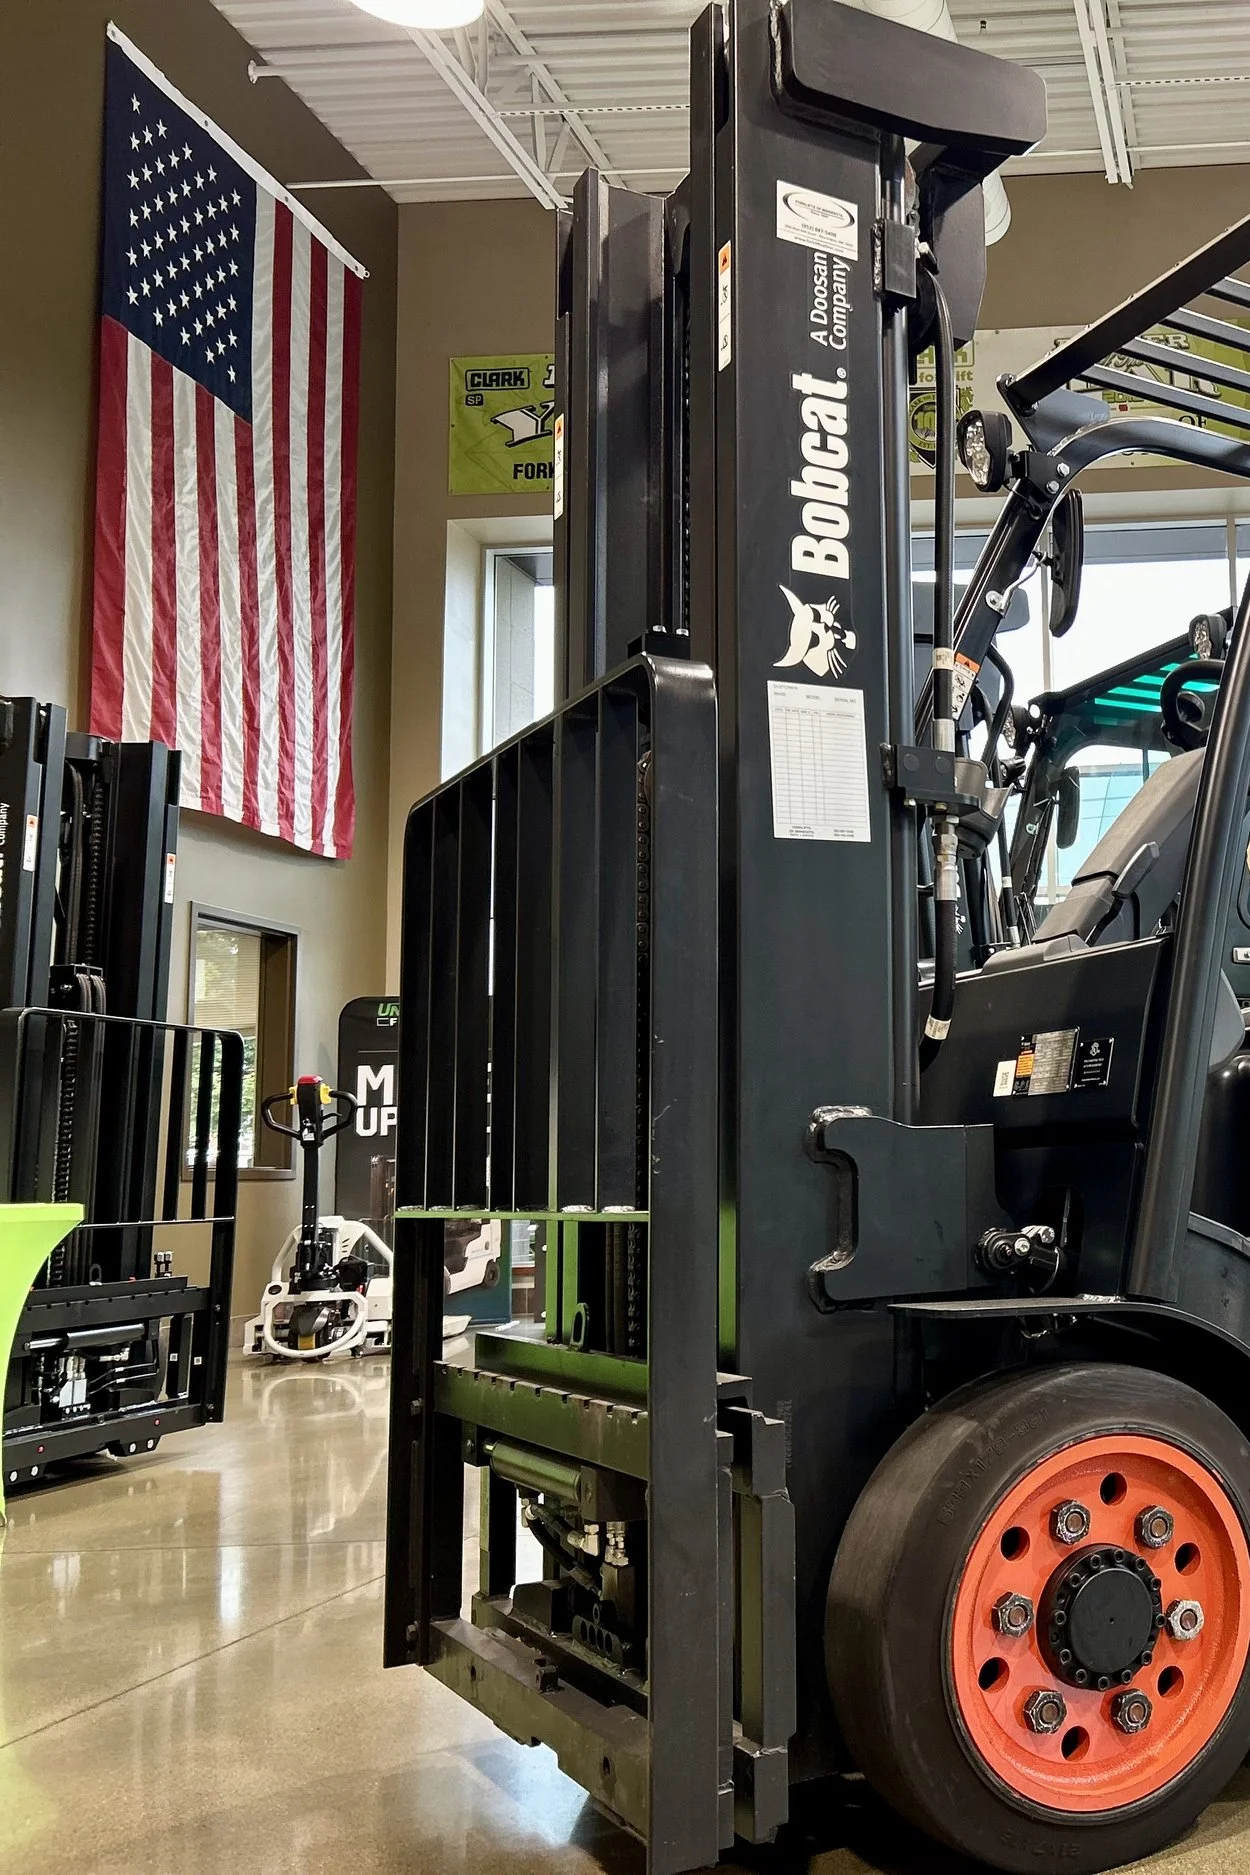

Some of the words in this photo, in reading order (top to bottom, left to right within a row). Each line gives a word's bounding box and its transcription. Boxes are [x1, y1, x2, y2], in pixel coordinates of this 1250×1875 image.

[810, 251, 828, 326] Doosan
[829, 256, 851, 351] Company
[810, 330, 828, 347] A
[470, 370, 525, 388] CLARK
[790, 372, 850, 580] Bobcat
